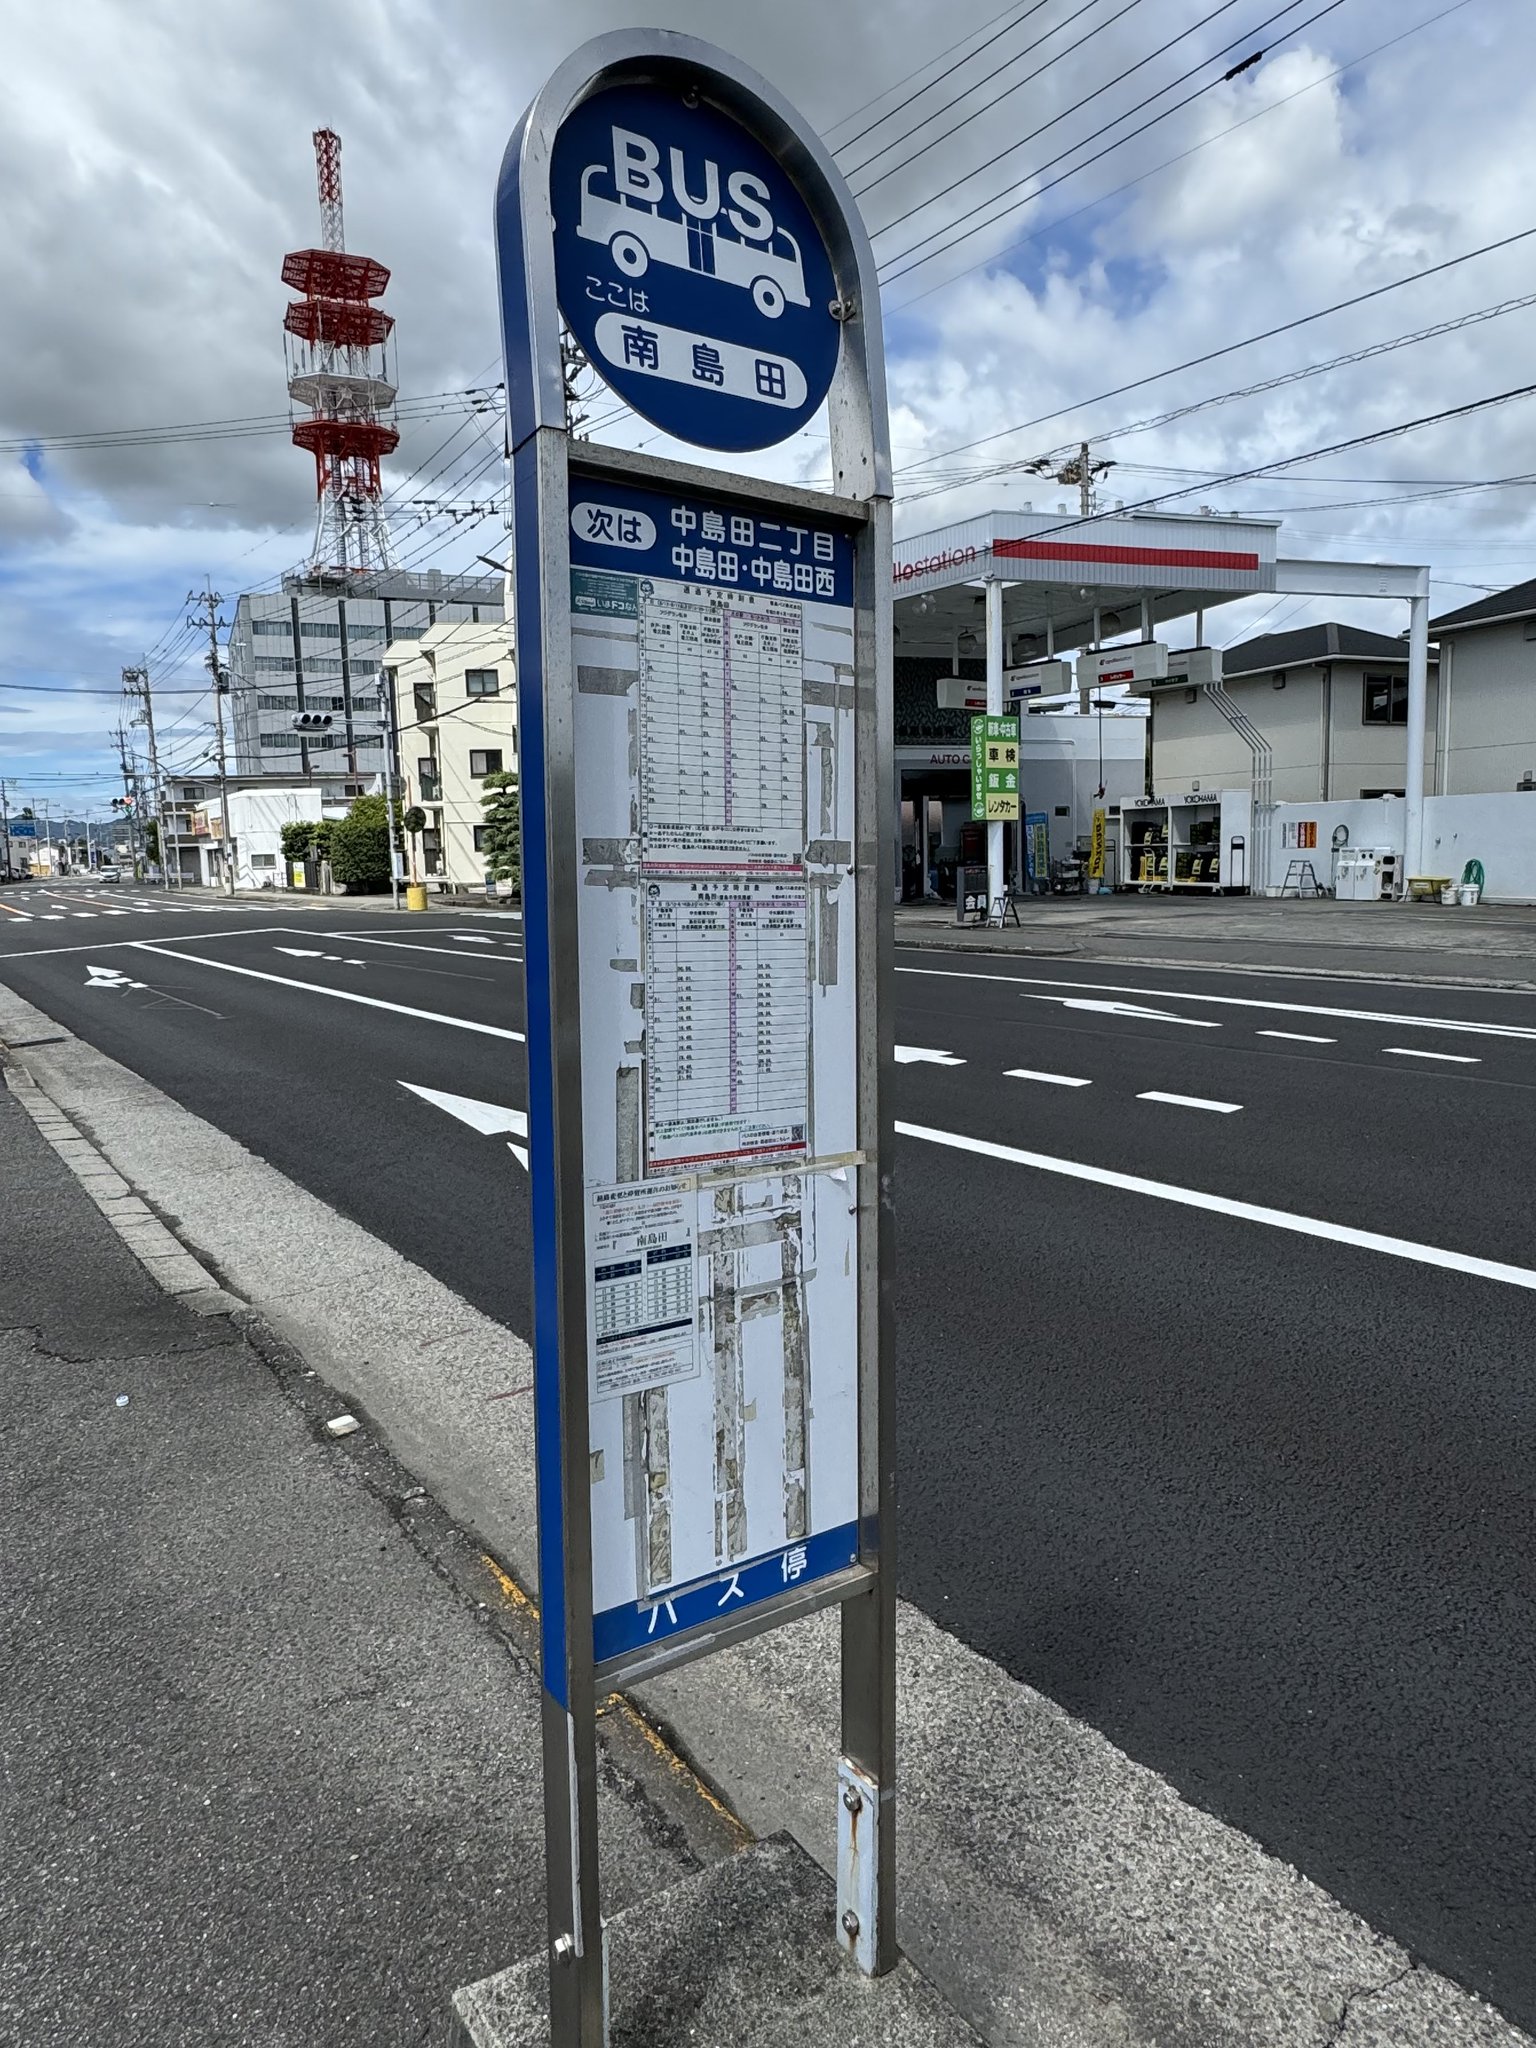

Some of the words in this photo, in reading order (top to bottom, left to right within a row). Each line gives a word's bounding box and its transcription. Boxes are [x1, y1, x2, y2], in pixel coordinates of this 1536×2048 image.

[612, 125, 773, 241] BUS
[585, 275, 650, 313] ここは
[621, 324, 786, 400] 南島田
[587, 508, 642, 543] 次は
[671, 505, 834, 562] 中島田二丁目
[672, 544, 835, 597] 中島田・中島田西
[930, 754, 960, 764] AUTO
[989, 747, 1016, 762] 車検
[988, 800, 1017, 813] レンタカー
